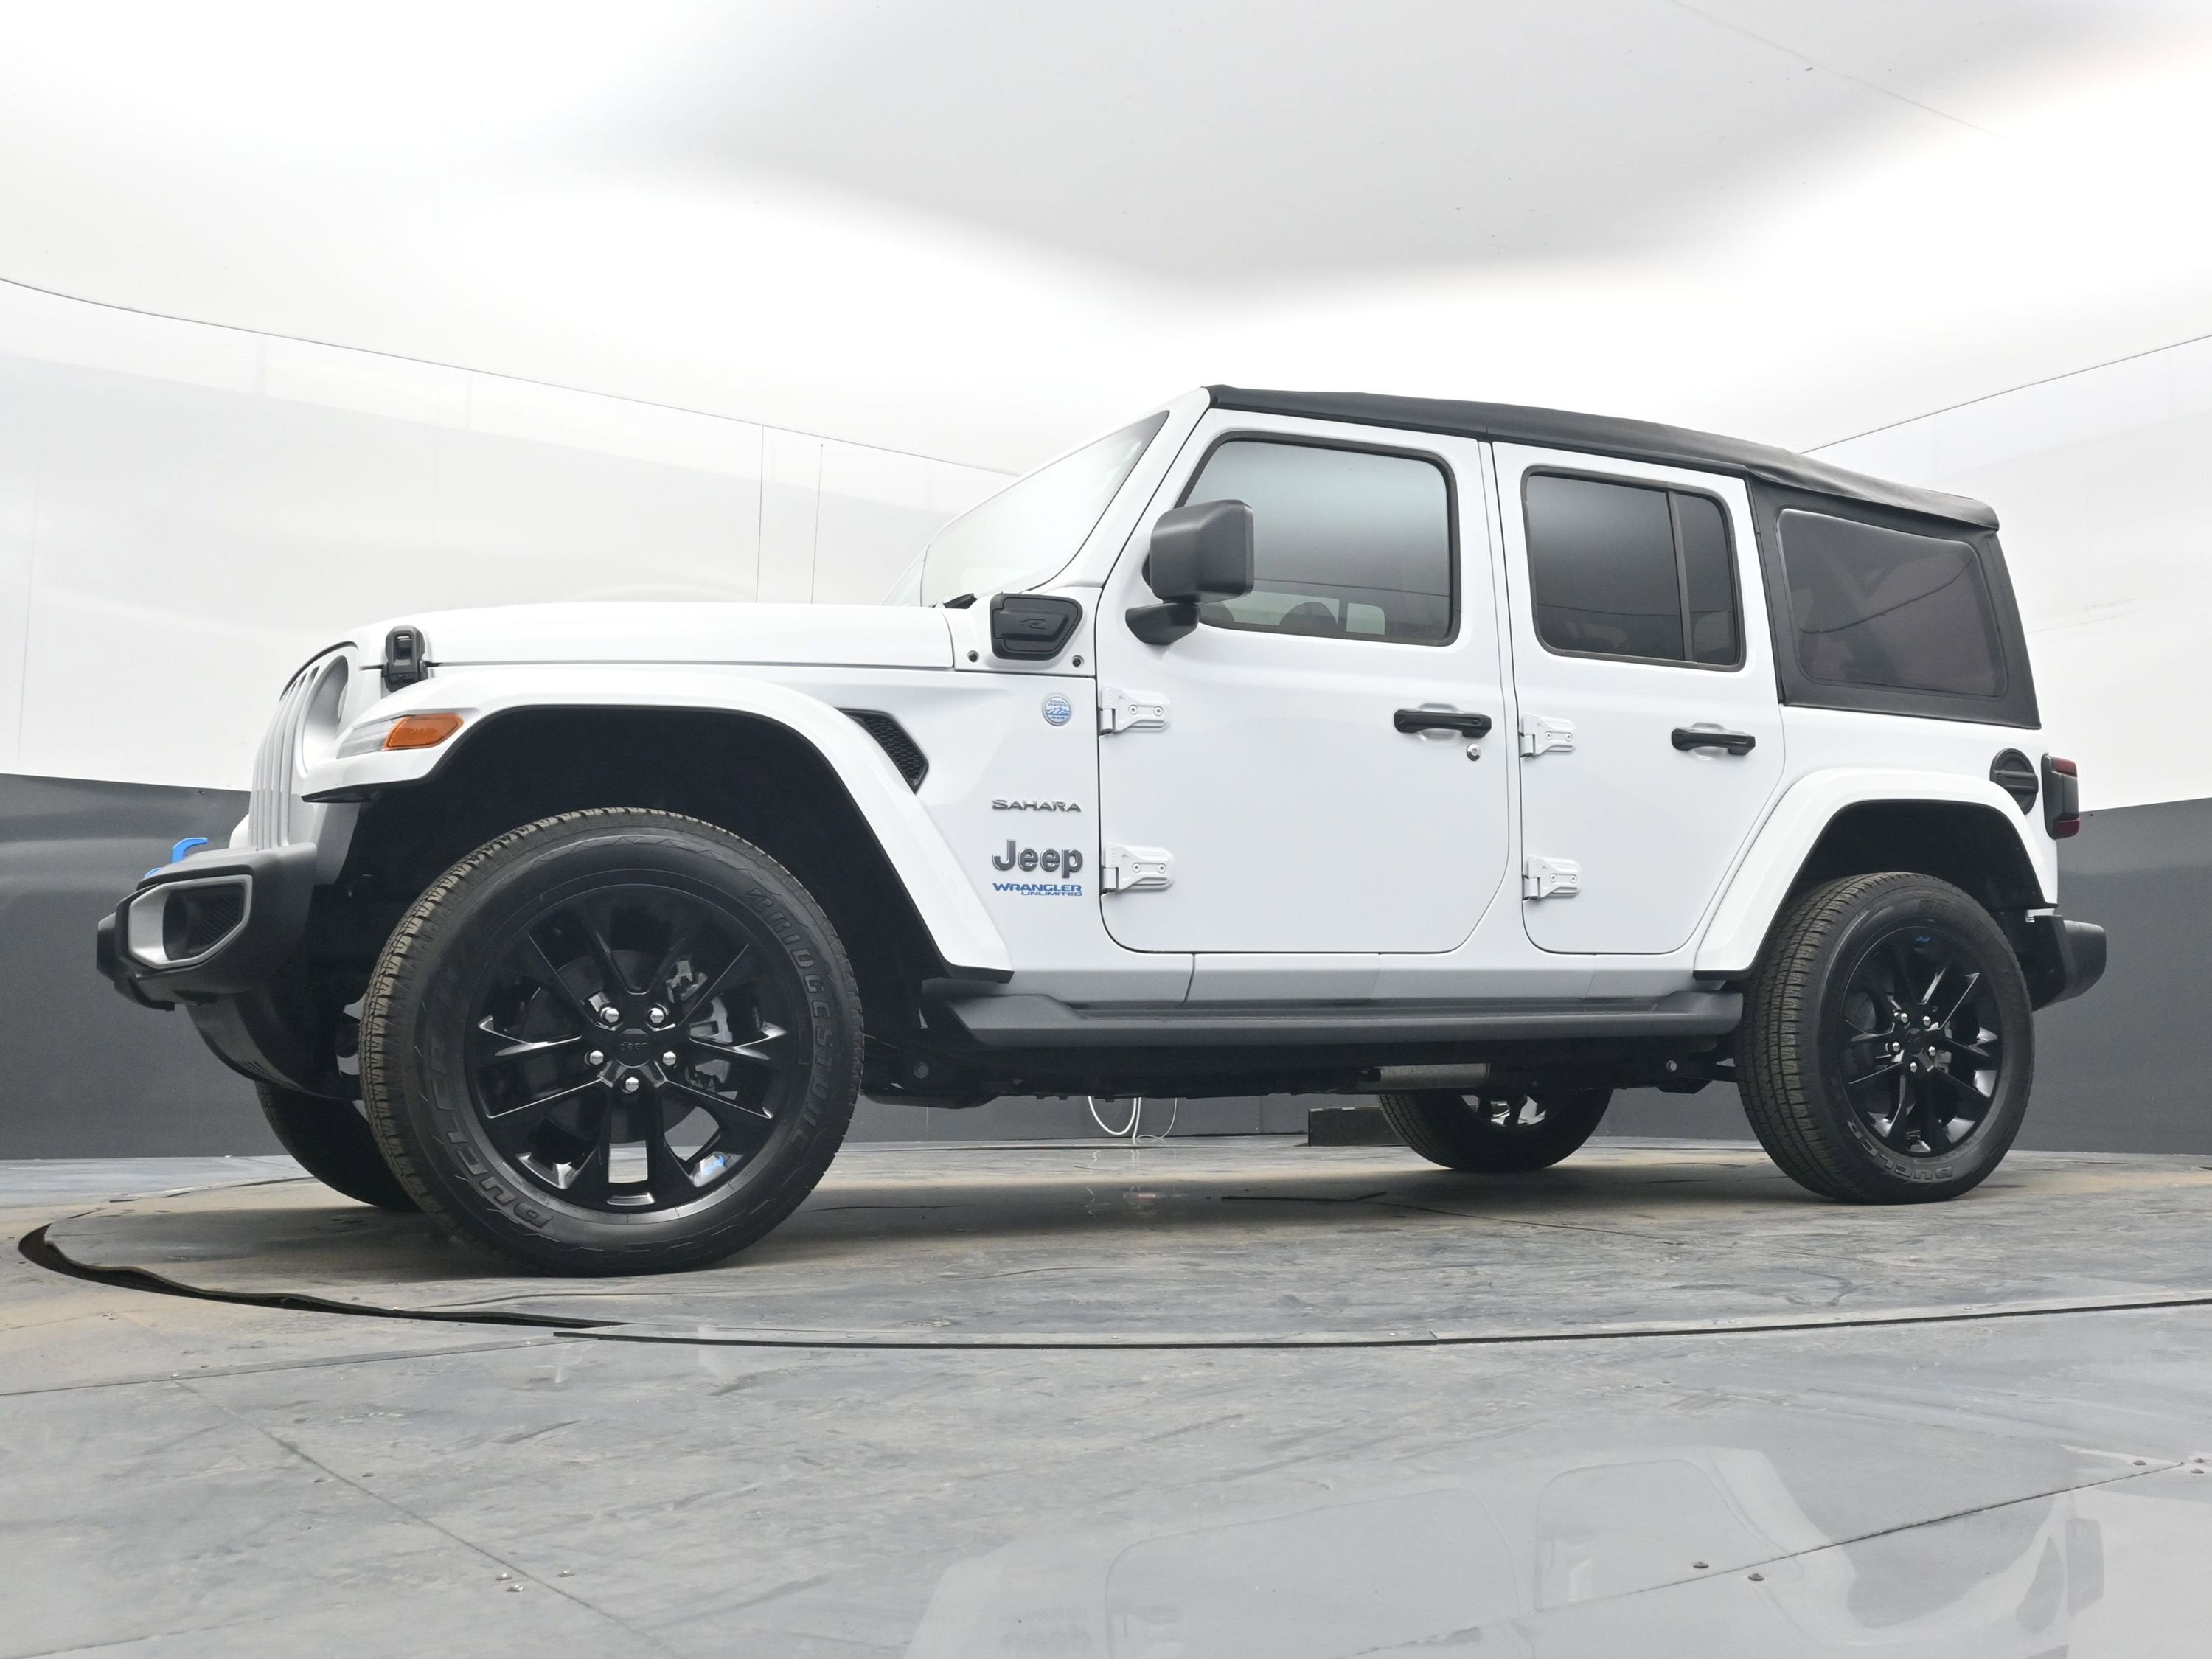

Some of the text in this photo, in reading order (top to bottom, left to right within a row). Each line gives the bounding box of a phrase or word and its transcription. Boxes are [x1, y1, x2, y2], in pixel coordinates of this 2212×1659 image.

[992, 799, 1082, 812] SAHARA
[992, 839, 1083, 879] Jeep
[992, 883, 1082, 892] WRANGLER
[746, 887, 833, 1151] BRIDGESTONE
[430, 1035, 554, 1229] DUELER
